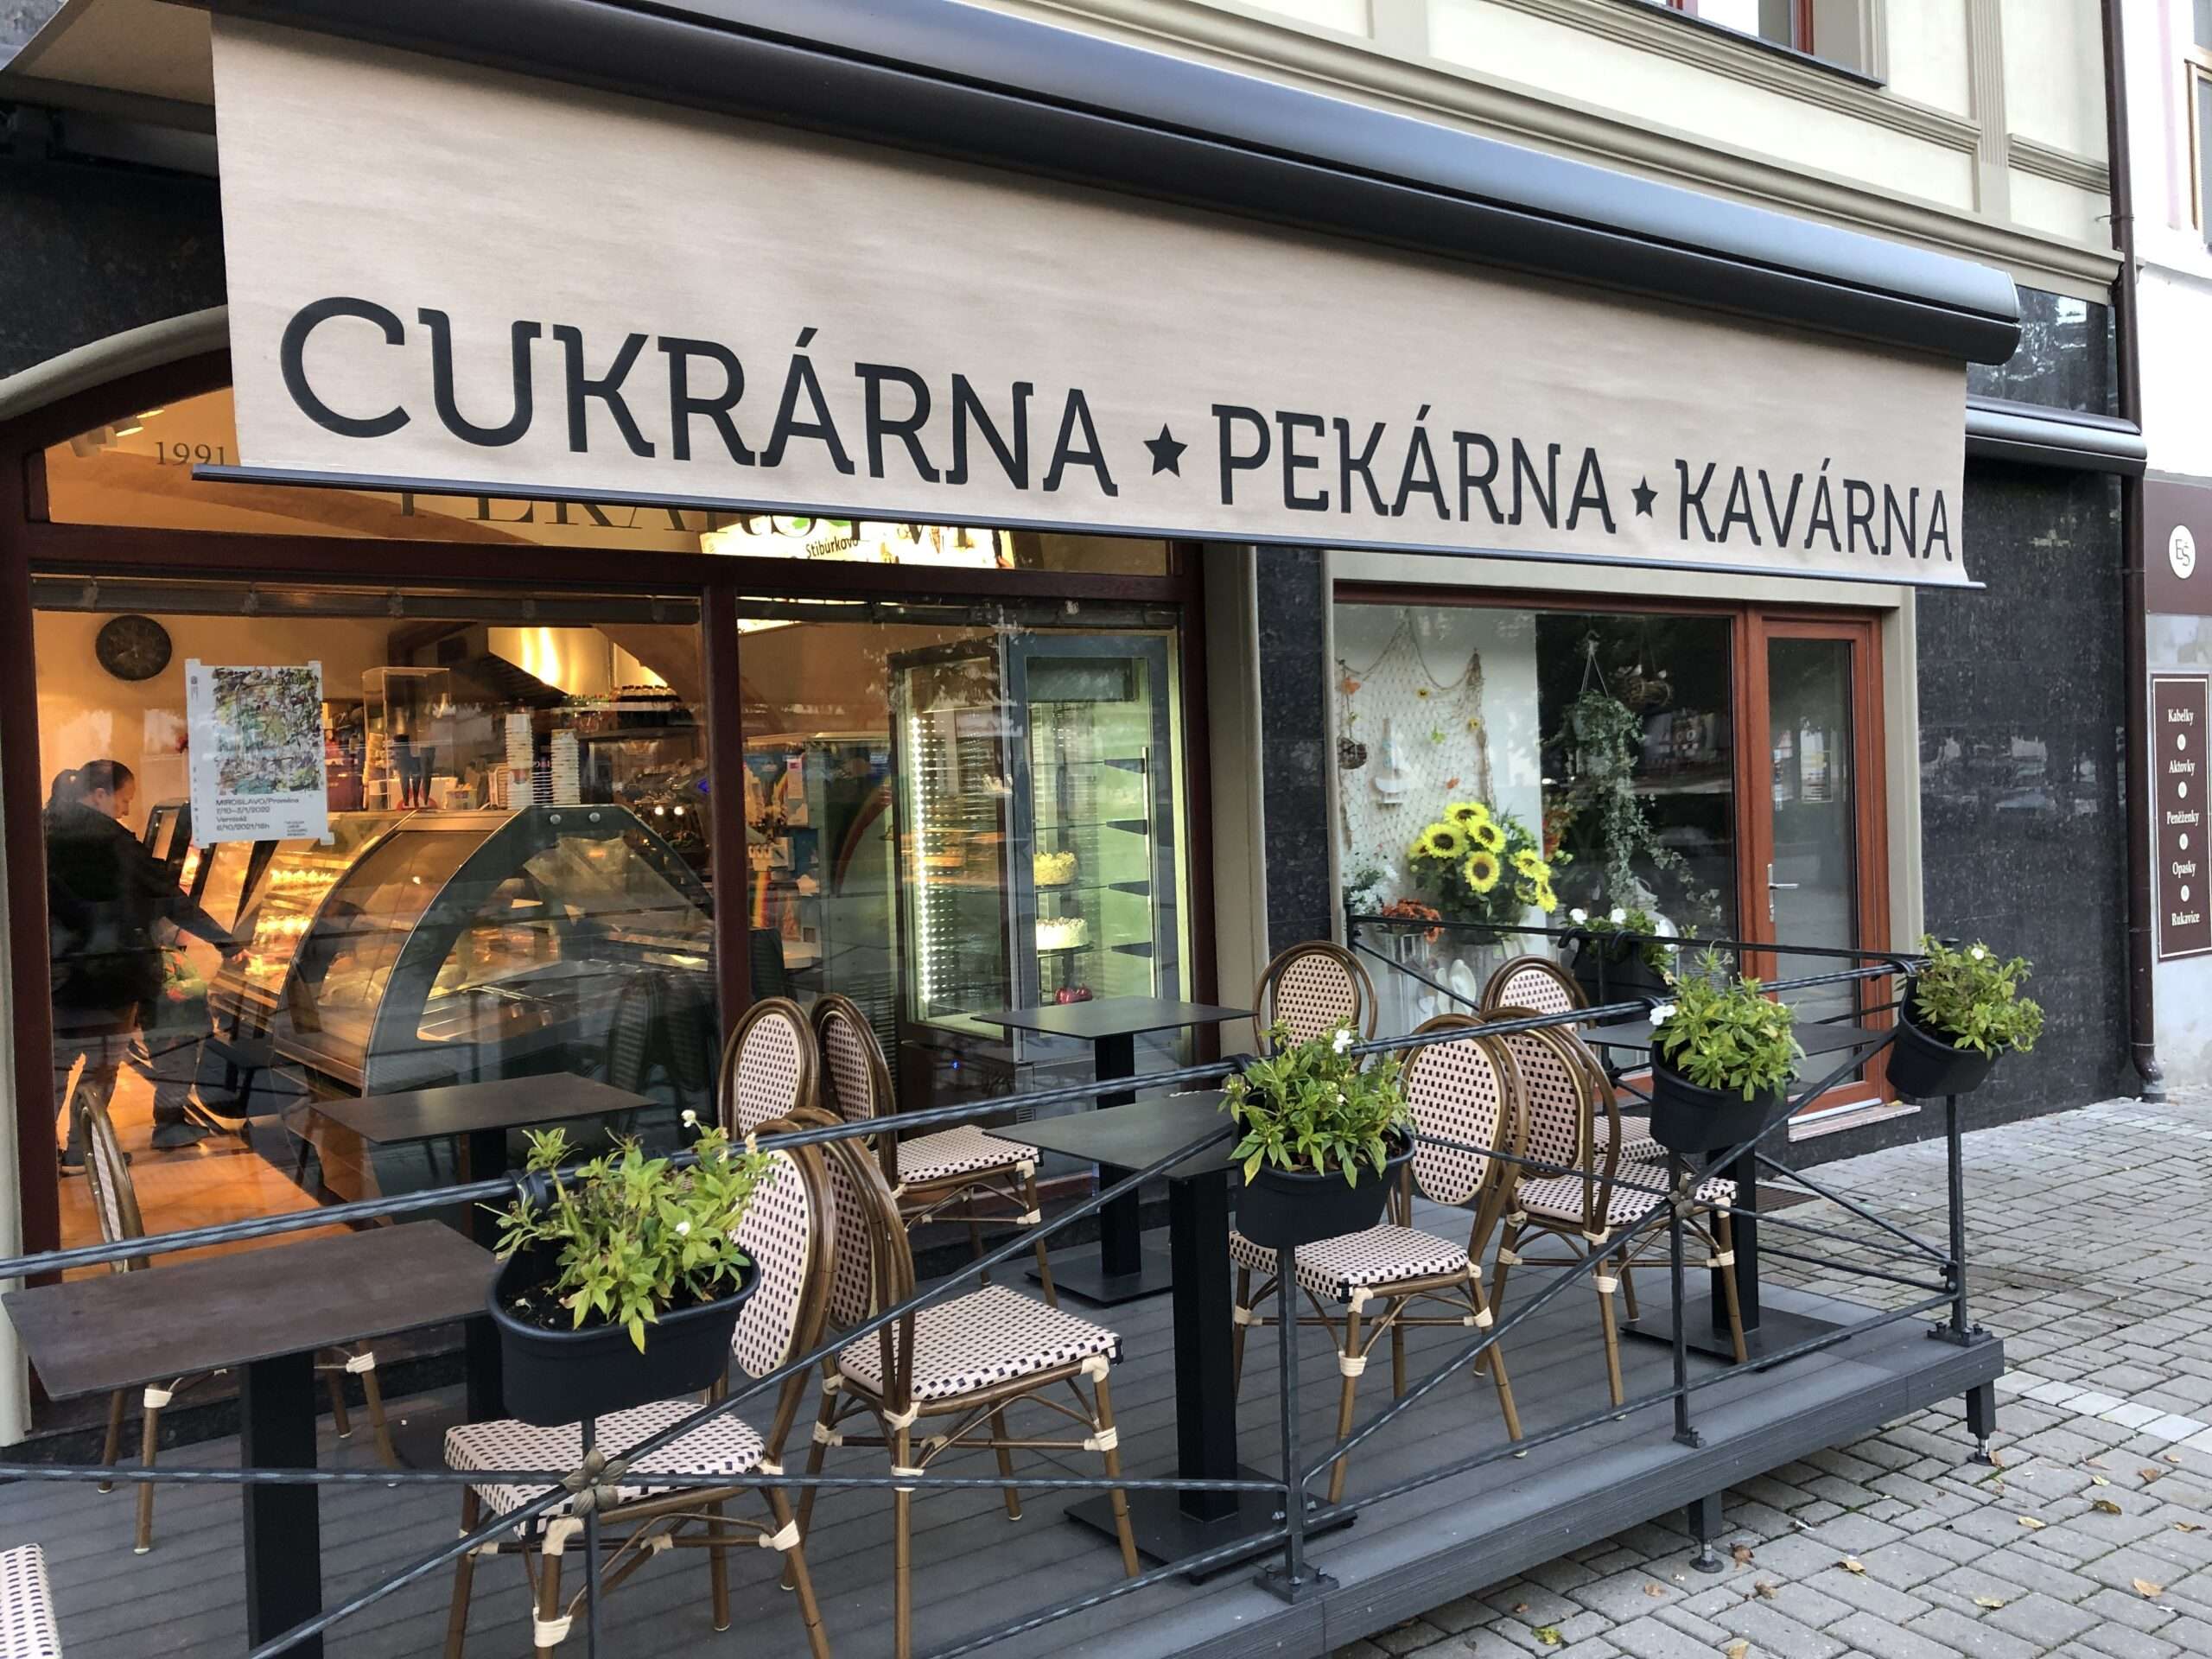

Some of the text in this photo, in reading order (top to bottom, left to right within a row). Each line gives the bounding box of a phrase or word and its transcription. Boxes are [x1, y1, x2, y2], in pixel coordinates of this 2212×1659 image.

[281, 297, 1951, 561] CUKRÁRNA PEKÁRNA KAVÁRNA
[155, 442, 225, 466] 1991
[2168, 709, 2194, 726] Kabelky
[2169, 760, 2195, 776] Aktovky
[2166, 810, 2199, 826] Peněženky
[2172, 861, 2196, 878] Opasky
[2171, 911, 2200, 926] Rukavice
